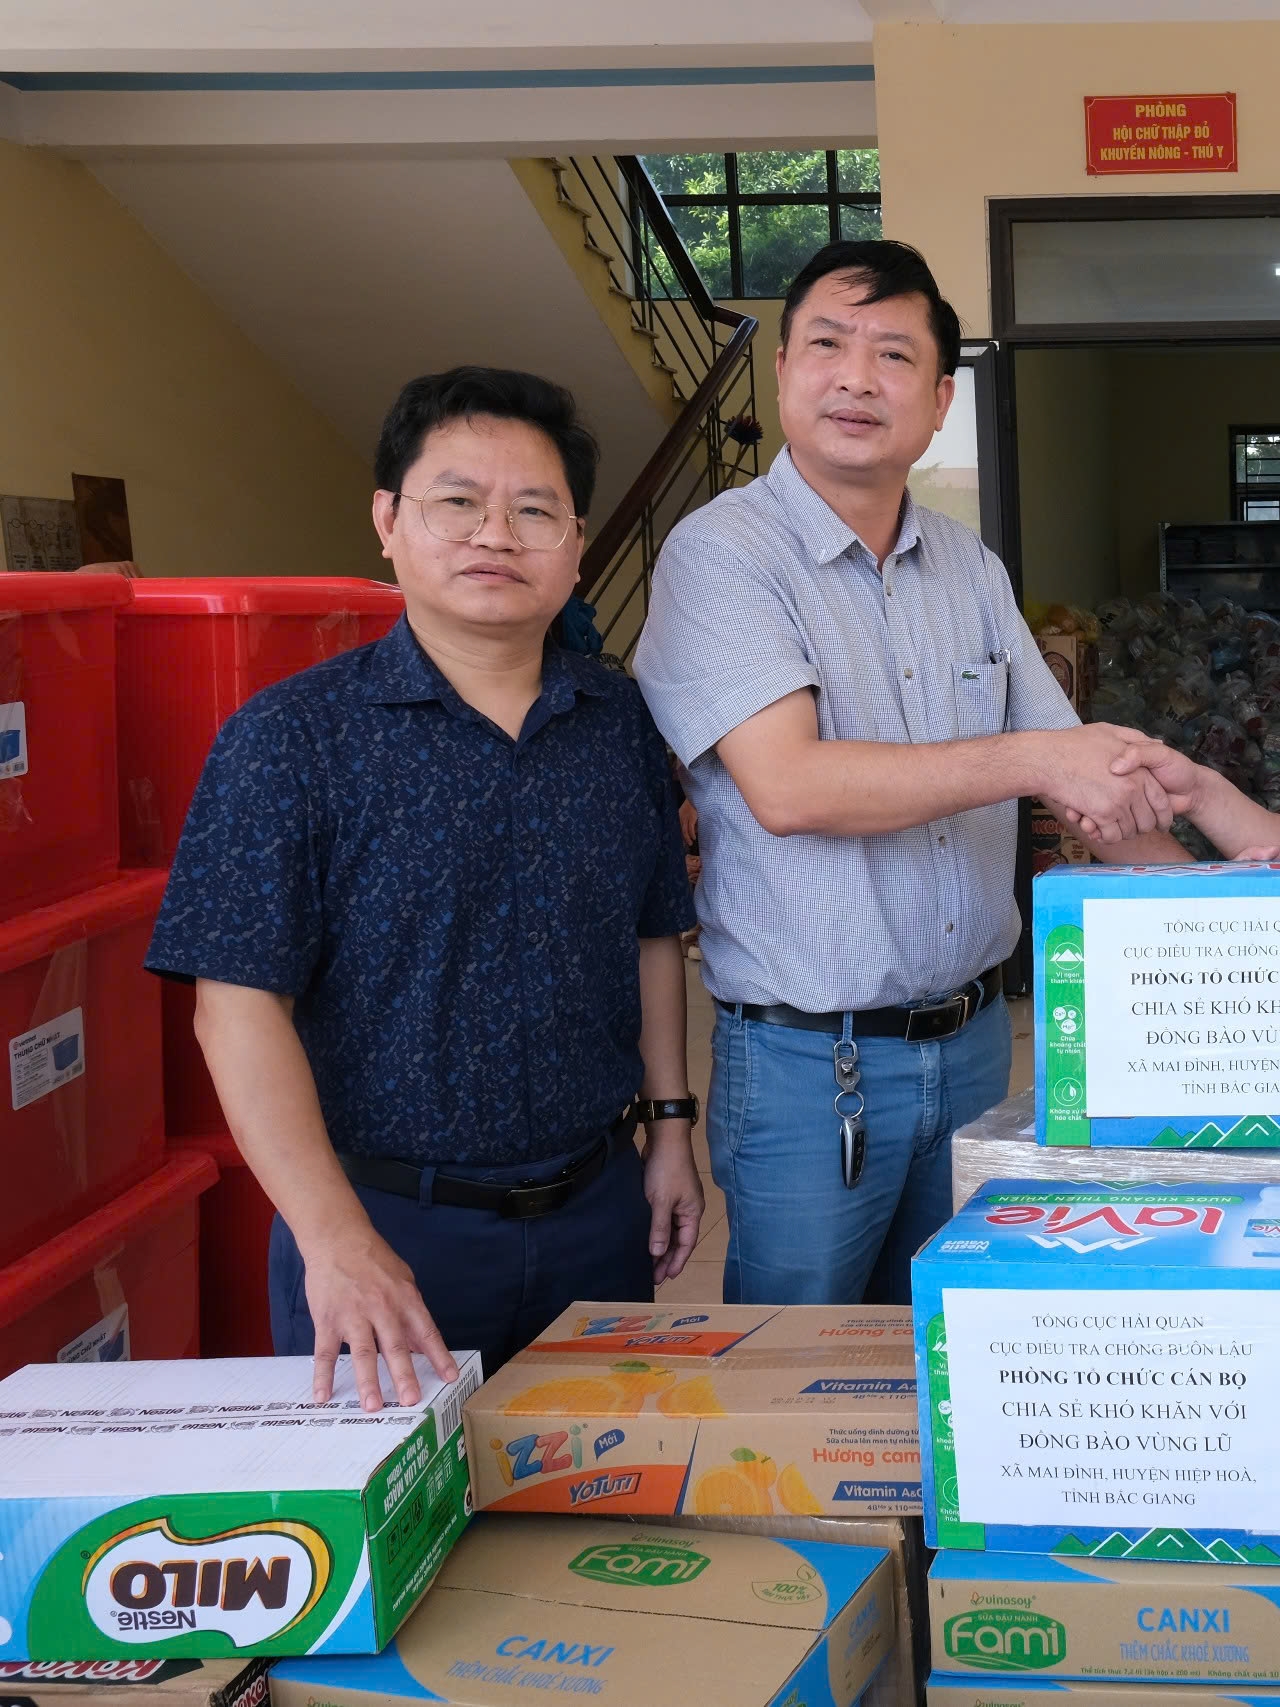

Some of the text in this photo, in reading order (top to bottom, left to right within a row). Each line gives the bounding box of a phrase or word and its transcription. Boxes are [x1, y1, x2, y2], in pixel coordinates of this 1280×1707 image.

[1135, 101, 1187, 118] PHÒNG
[1113, 121, 1210, 143] HỘI CHỮ THẬP ĐỎ
[1148, 144, 1181, 160] NÔNG
[1192, 143, 1214, 159] THÚ
[1216, 145, 1224, 159] Y
[1130, 968, 1193, 985] PHÒNG
[1228, 966, 1279, 984] CHỨC
[1131, 1001, 1177, 1016] CHIA
[1210, 996, 1251, 1015] KHÓ
[1207, 1026, 1246, 1044] BÀO
[1128, 1058, 1149, 1073] XÃ
[1152, 1060, 1180, 1072] MAI
[1083, 1316, 1117, 1331] CỤC
[1155, 1316, 1204, 1331] QUAN
[1000, 1366, 1068, 1385] PHÒNG
[1107, 1368, 1165, 1386] CHỨC
[1171, 1368, 1213, 1386] CÁN
[820, 1382, 892, 1391] Vitamin
[1002, 1401, 1053, 1418] CHIA
[1090, 1399, 1135, 1419] KHÓ
[1141, 1400, 1201, 1419] KHĂN
[1209, 1400, 1248, 1420] VỚI
[597, 1432, 618, 1449] Mới
[1086, 1430, 1130, 1451] BÀO
[1136, 1431, 1198, 1451] VÙNG
[1204, 1433, 1232, 1452] LŨ
[812, 1447, 921, 1467] Hương cam
[1001, 1462, 1023, 1478] XÃ
[1028, 1466, 1059, 1478] MAI
[843, 1484, 897, 1498] Vitamin
[1142, 1493, 1196, 1506] GIANG
[109, 1556, 292, 1612] MILO
[1137, 1607, 1231, 1633] CANXI
[495, 1634, 617, 1668] CANXI
